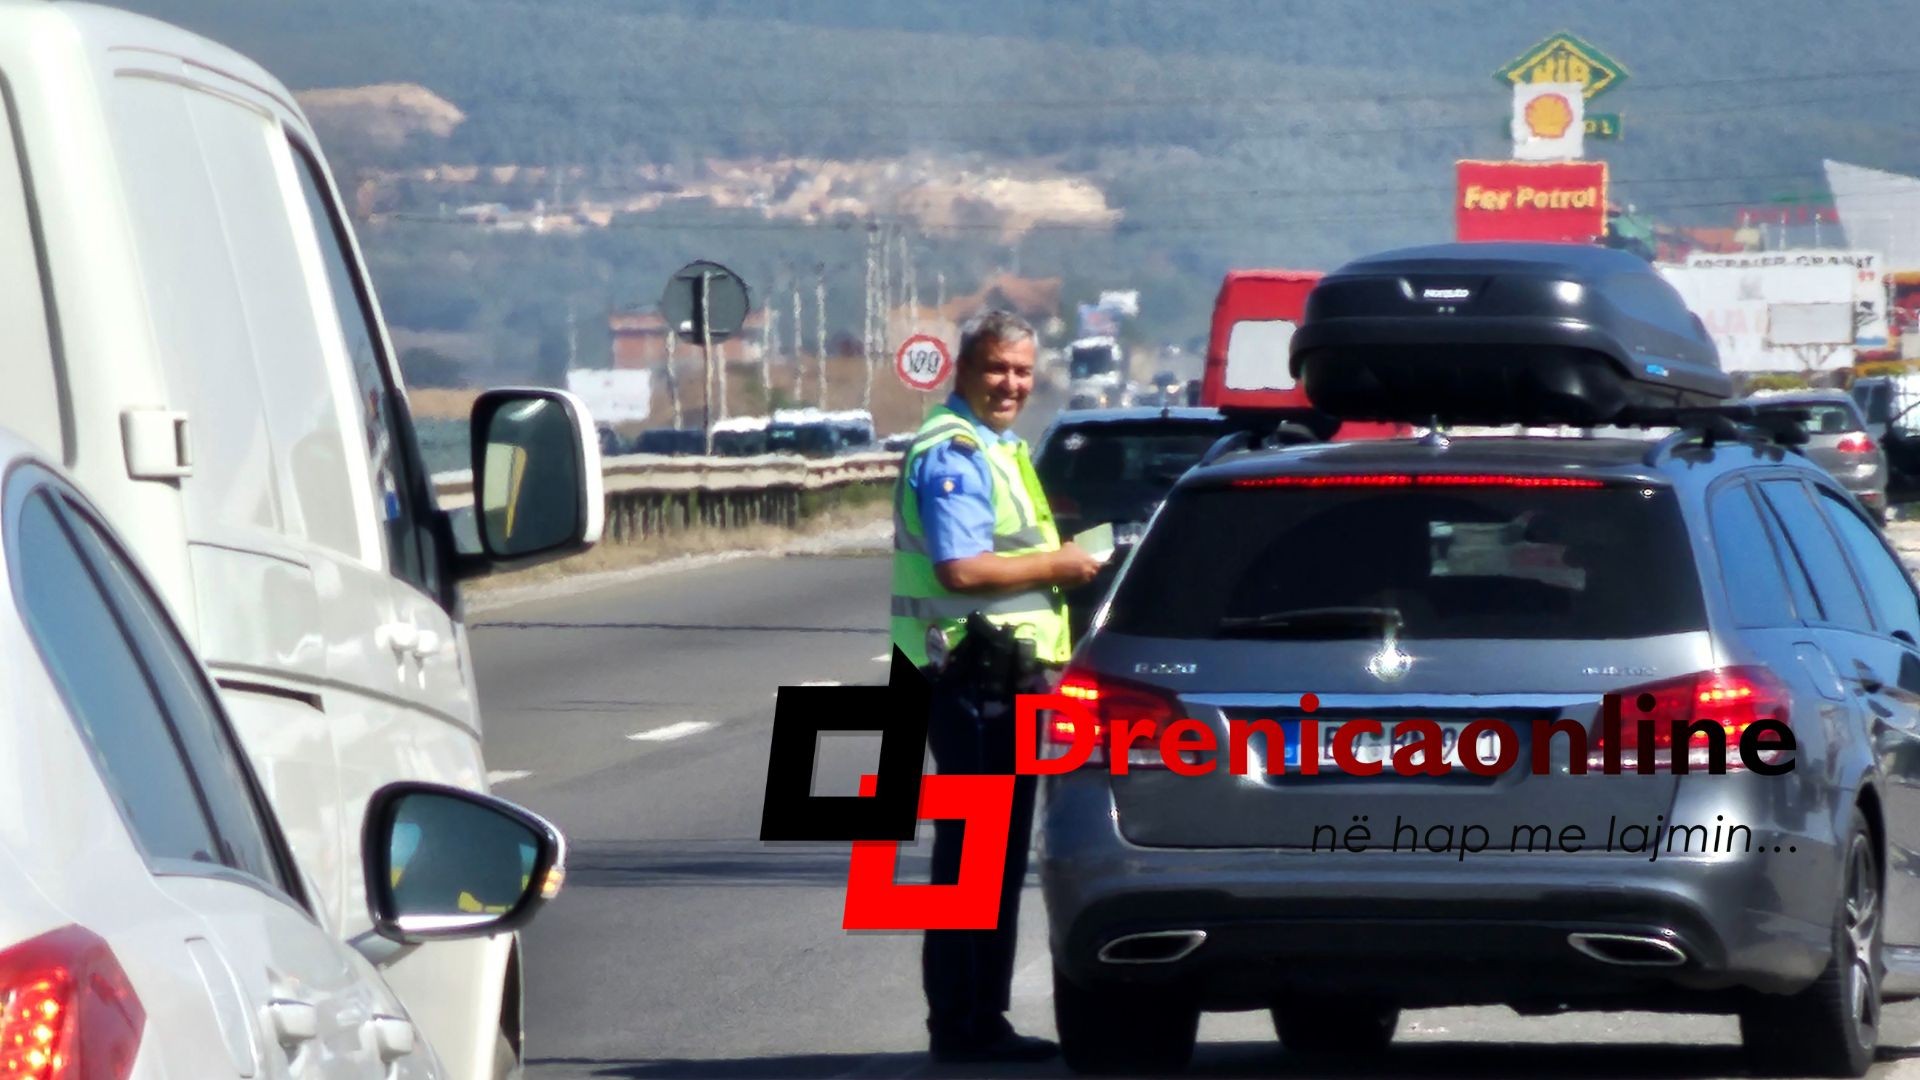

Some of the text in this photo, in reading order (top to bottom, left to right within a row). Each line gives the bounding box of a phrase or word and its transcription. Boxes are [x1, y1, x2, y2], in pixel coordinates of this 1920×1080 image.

[1464, 185, 1597, 210] Fer Petrol
[908, 348, 940, 374] 100
